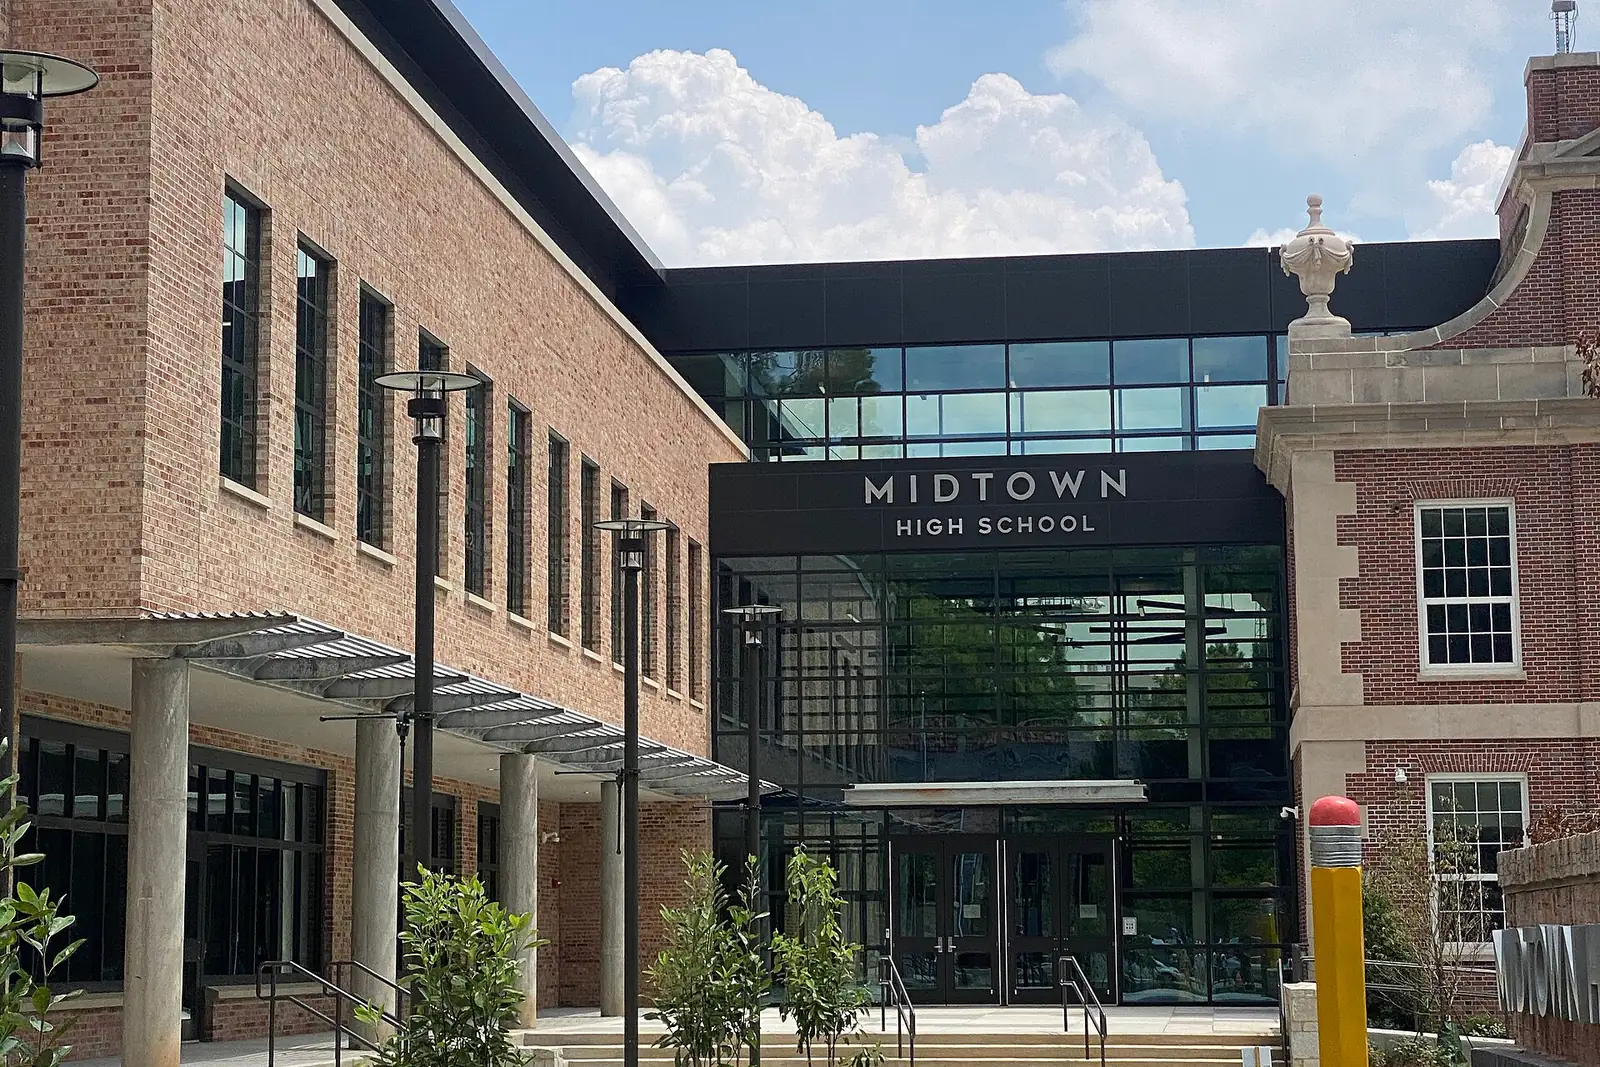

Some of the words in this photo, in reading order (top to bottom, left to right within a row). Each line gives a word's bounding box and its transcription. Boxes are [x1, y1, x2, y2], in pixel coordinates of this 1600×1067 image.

[864, 470, 1127, 504] MIDTOWN
[896, 518, 963, 536] HIGH
[978, 515, 1095, 534] SCHOOL
